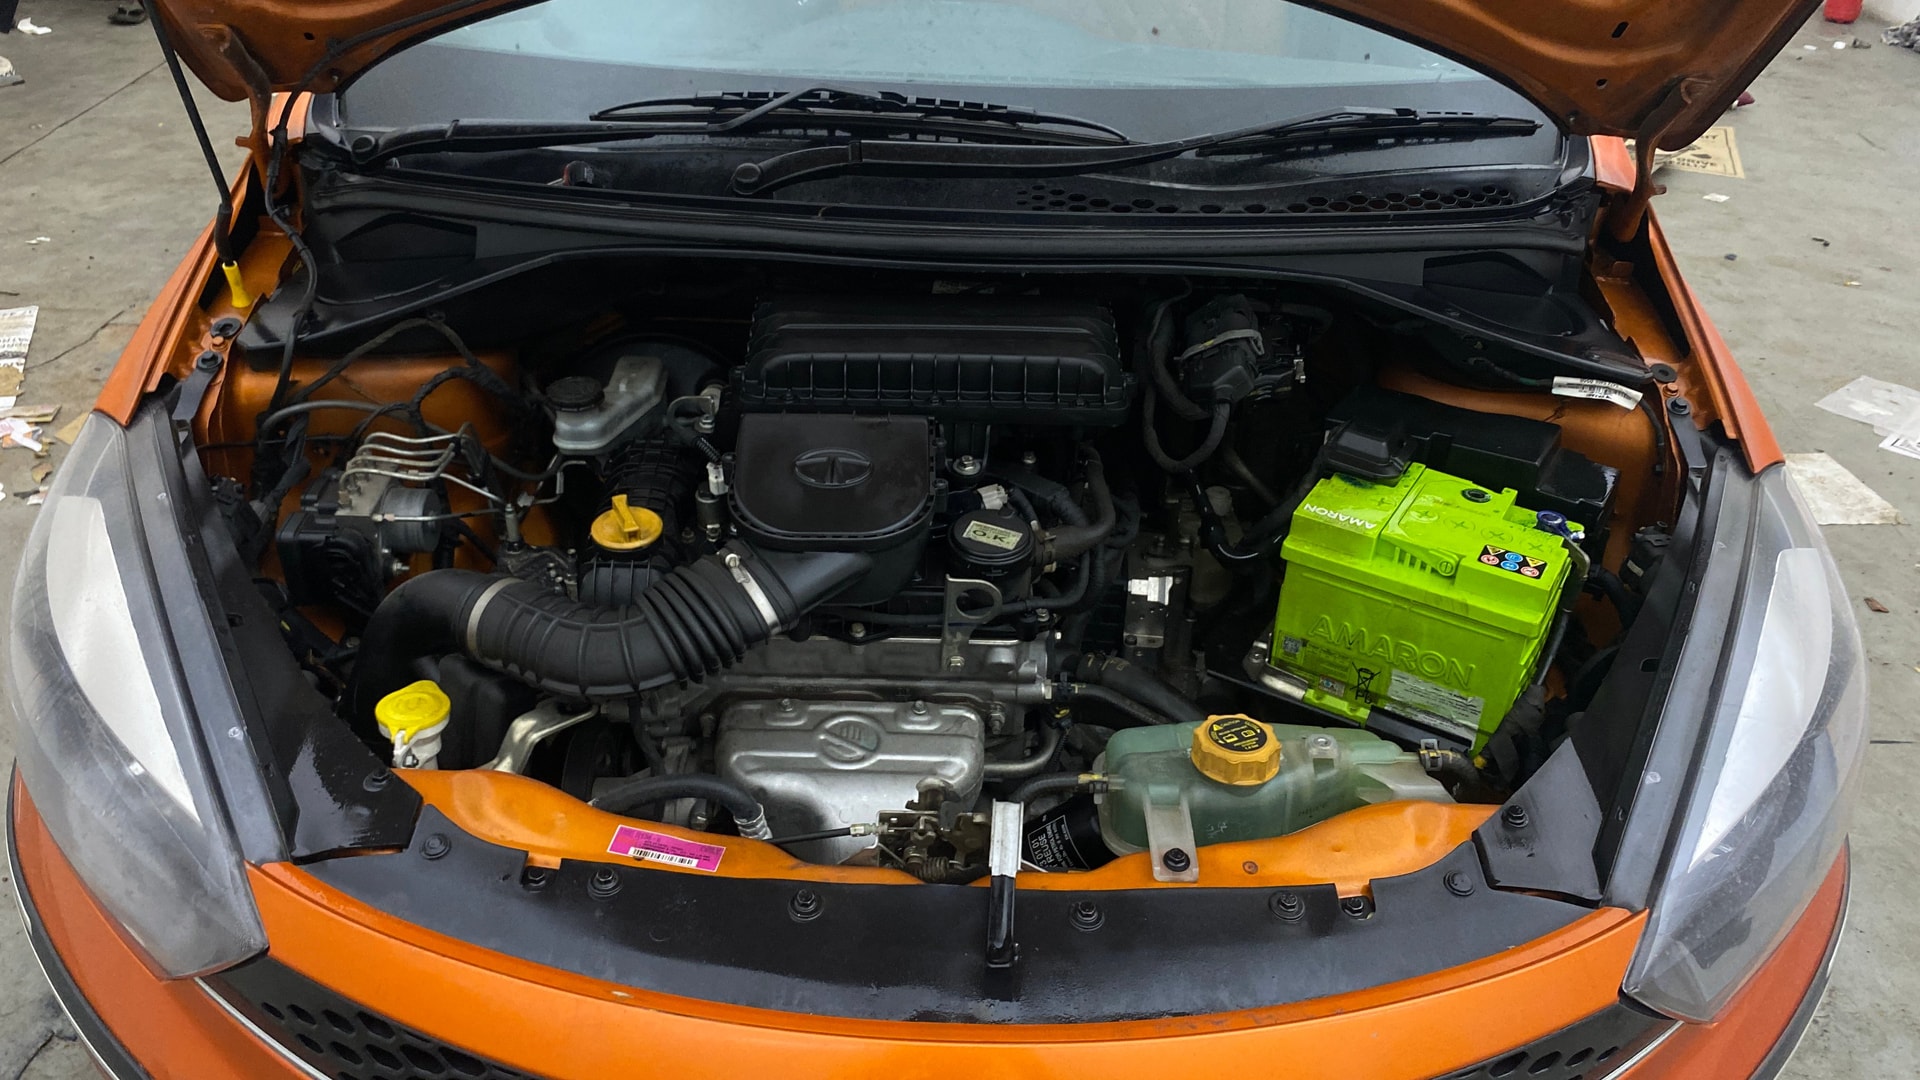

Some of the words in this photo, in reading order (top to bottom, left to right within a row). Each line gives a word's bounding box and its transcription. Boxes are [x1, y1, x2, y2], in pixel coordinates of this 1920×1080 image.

[1304, 502, 1378, 530] AMARON
[1308, 614, 1476, 690] AMARON
[1037, 833, 1055, 864] REUSE
